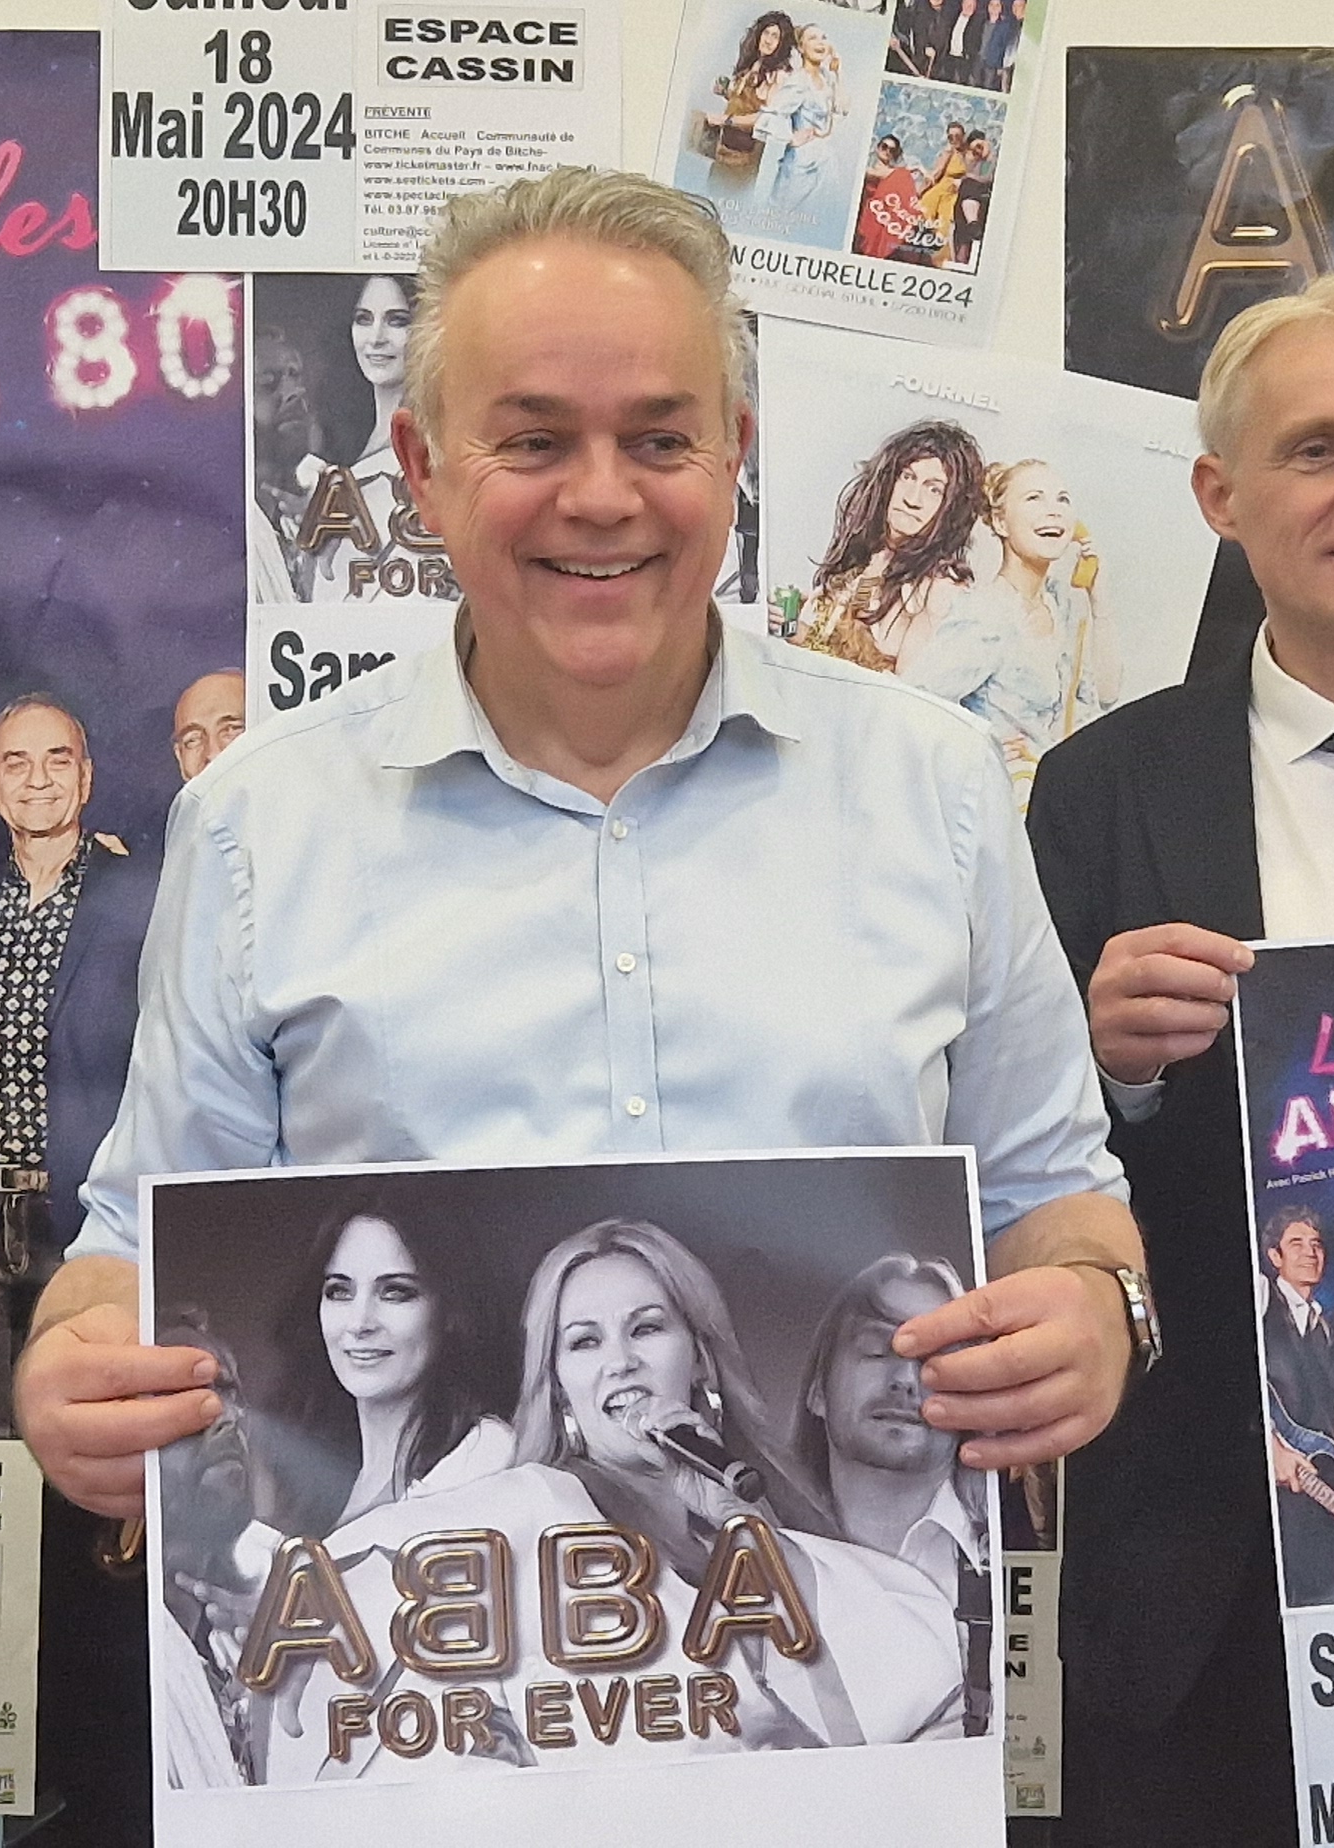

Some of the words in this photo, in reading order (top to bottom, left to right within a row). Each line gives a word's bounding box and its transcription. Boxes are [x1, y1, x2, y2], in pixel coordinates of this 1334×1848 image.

[204, 29, 272, 84] 18
[384, 18, 578, 46] ESPACE
[386, 56, 574, 83] CASSIN
[112, 92, 204, 158] Mai
[224, 92, 356, 159] 2024
[364, 129, 410, 139] BITCHE
[421, 130, 466, 140] Accueil
[477, 130, 556, 142] Communauté
[560, 131, 574, 142] de
[364, 144, 432, 155] Communes
[435, 145, 450, 155] du
[455, 146, 482, 158] Pays
[487, 146, 502, 156] de
[178, 180, 306, 236] 20H30
[752, 249, 896, 294] CULTURELLE
[902, 275, 973, 308] 2024
[43, 272, 241, 411] 80
[347, 558, 449, 597] FOR
[236, 1515, 819, 1691] ABBA
[328, 1686, 496, 1763] FOR
[526, 1673, 740, 1751] EVER
